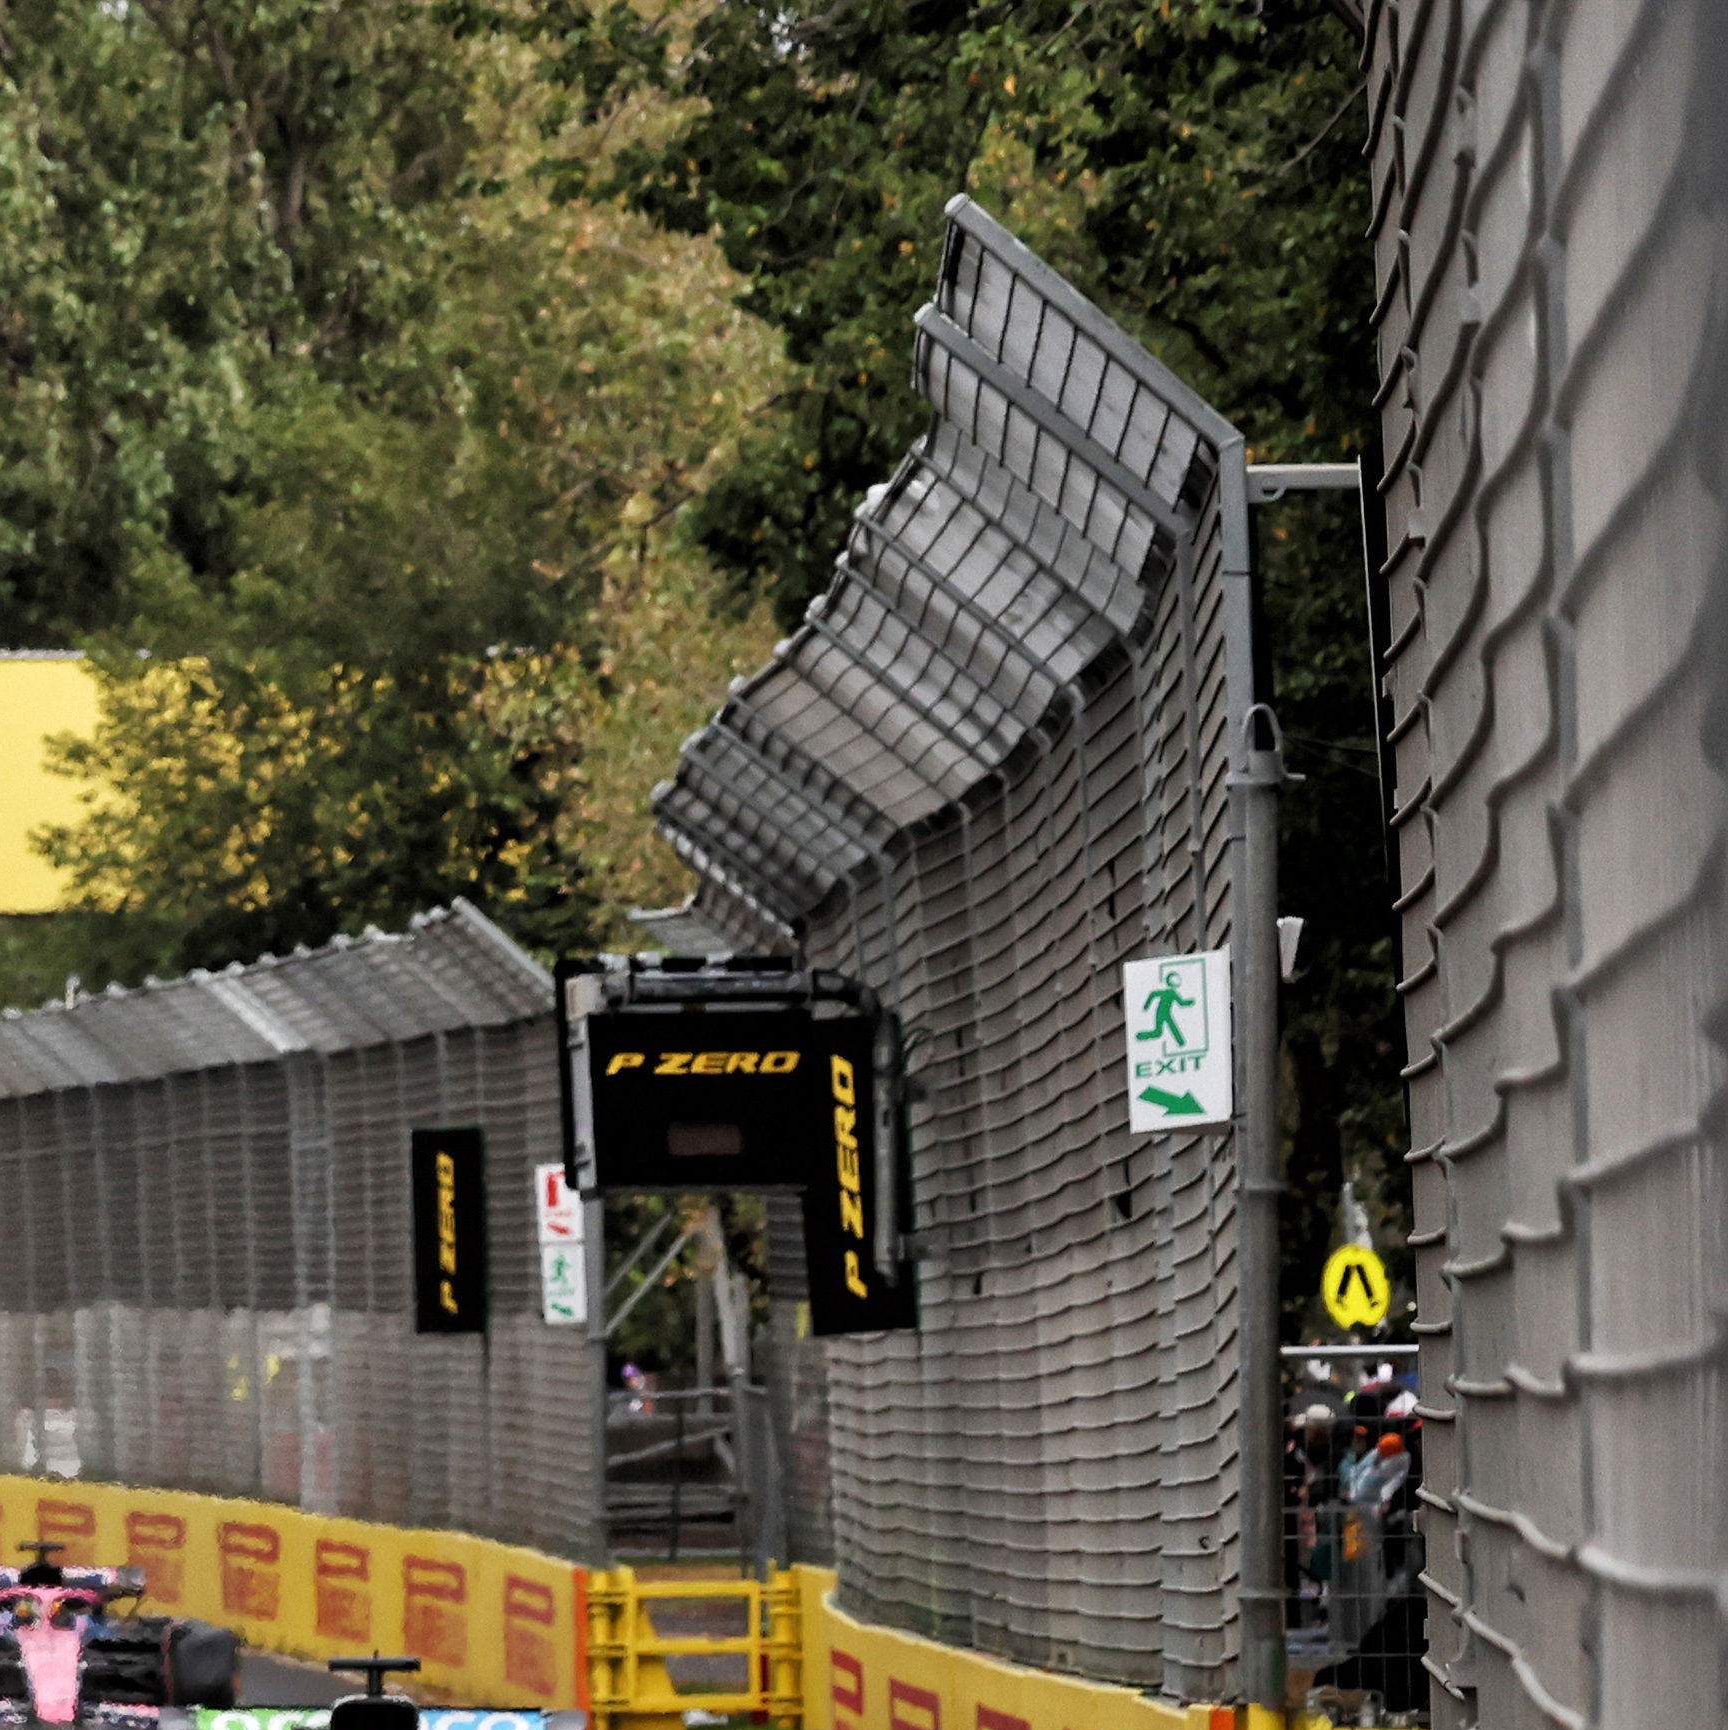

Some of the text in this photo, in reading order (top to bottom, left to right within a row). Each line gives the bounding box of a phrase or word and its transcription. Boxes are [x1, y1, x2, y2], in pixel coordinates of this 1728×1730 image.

[606, 1051, 800, 1076] P ZERO
[1135, 1055, 1204, 1078] EXIT
[830, 1054, 868, 1299] P ZERO
